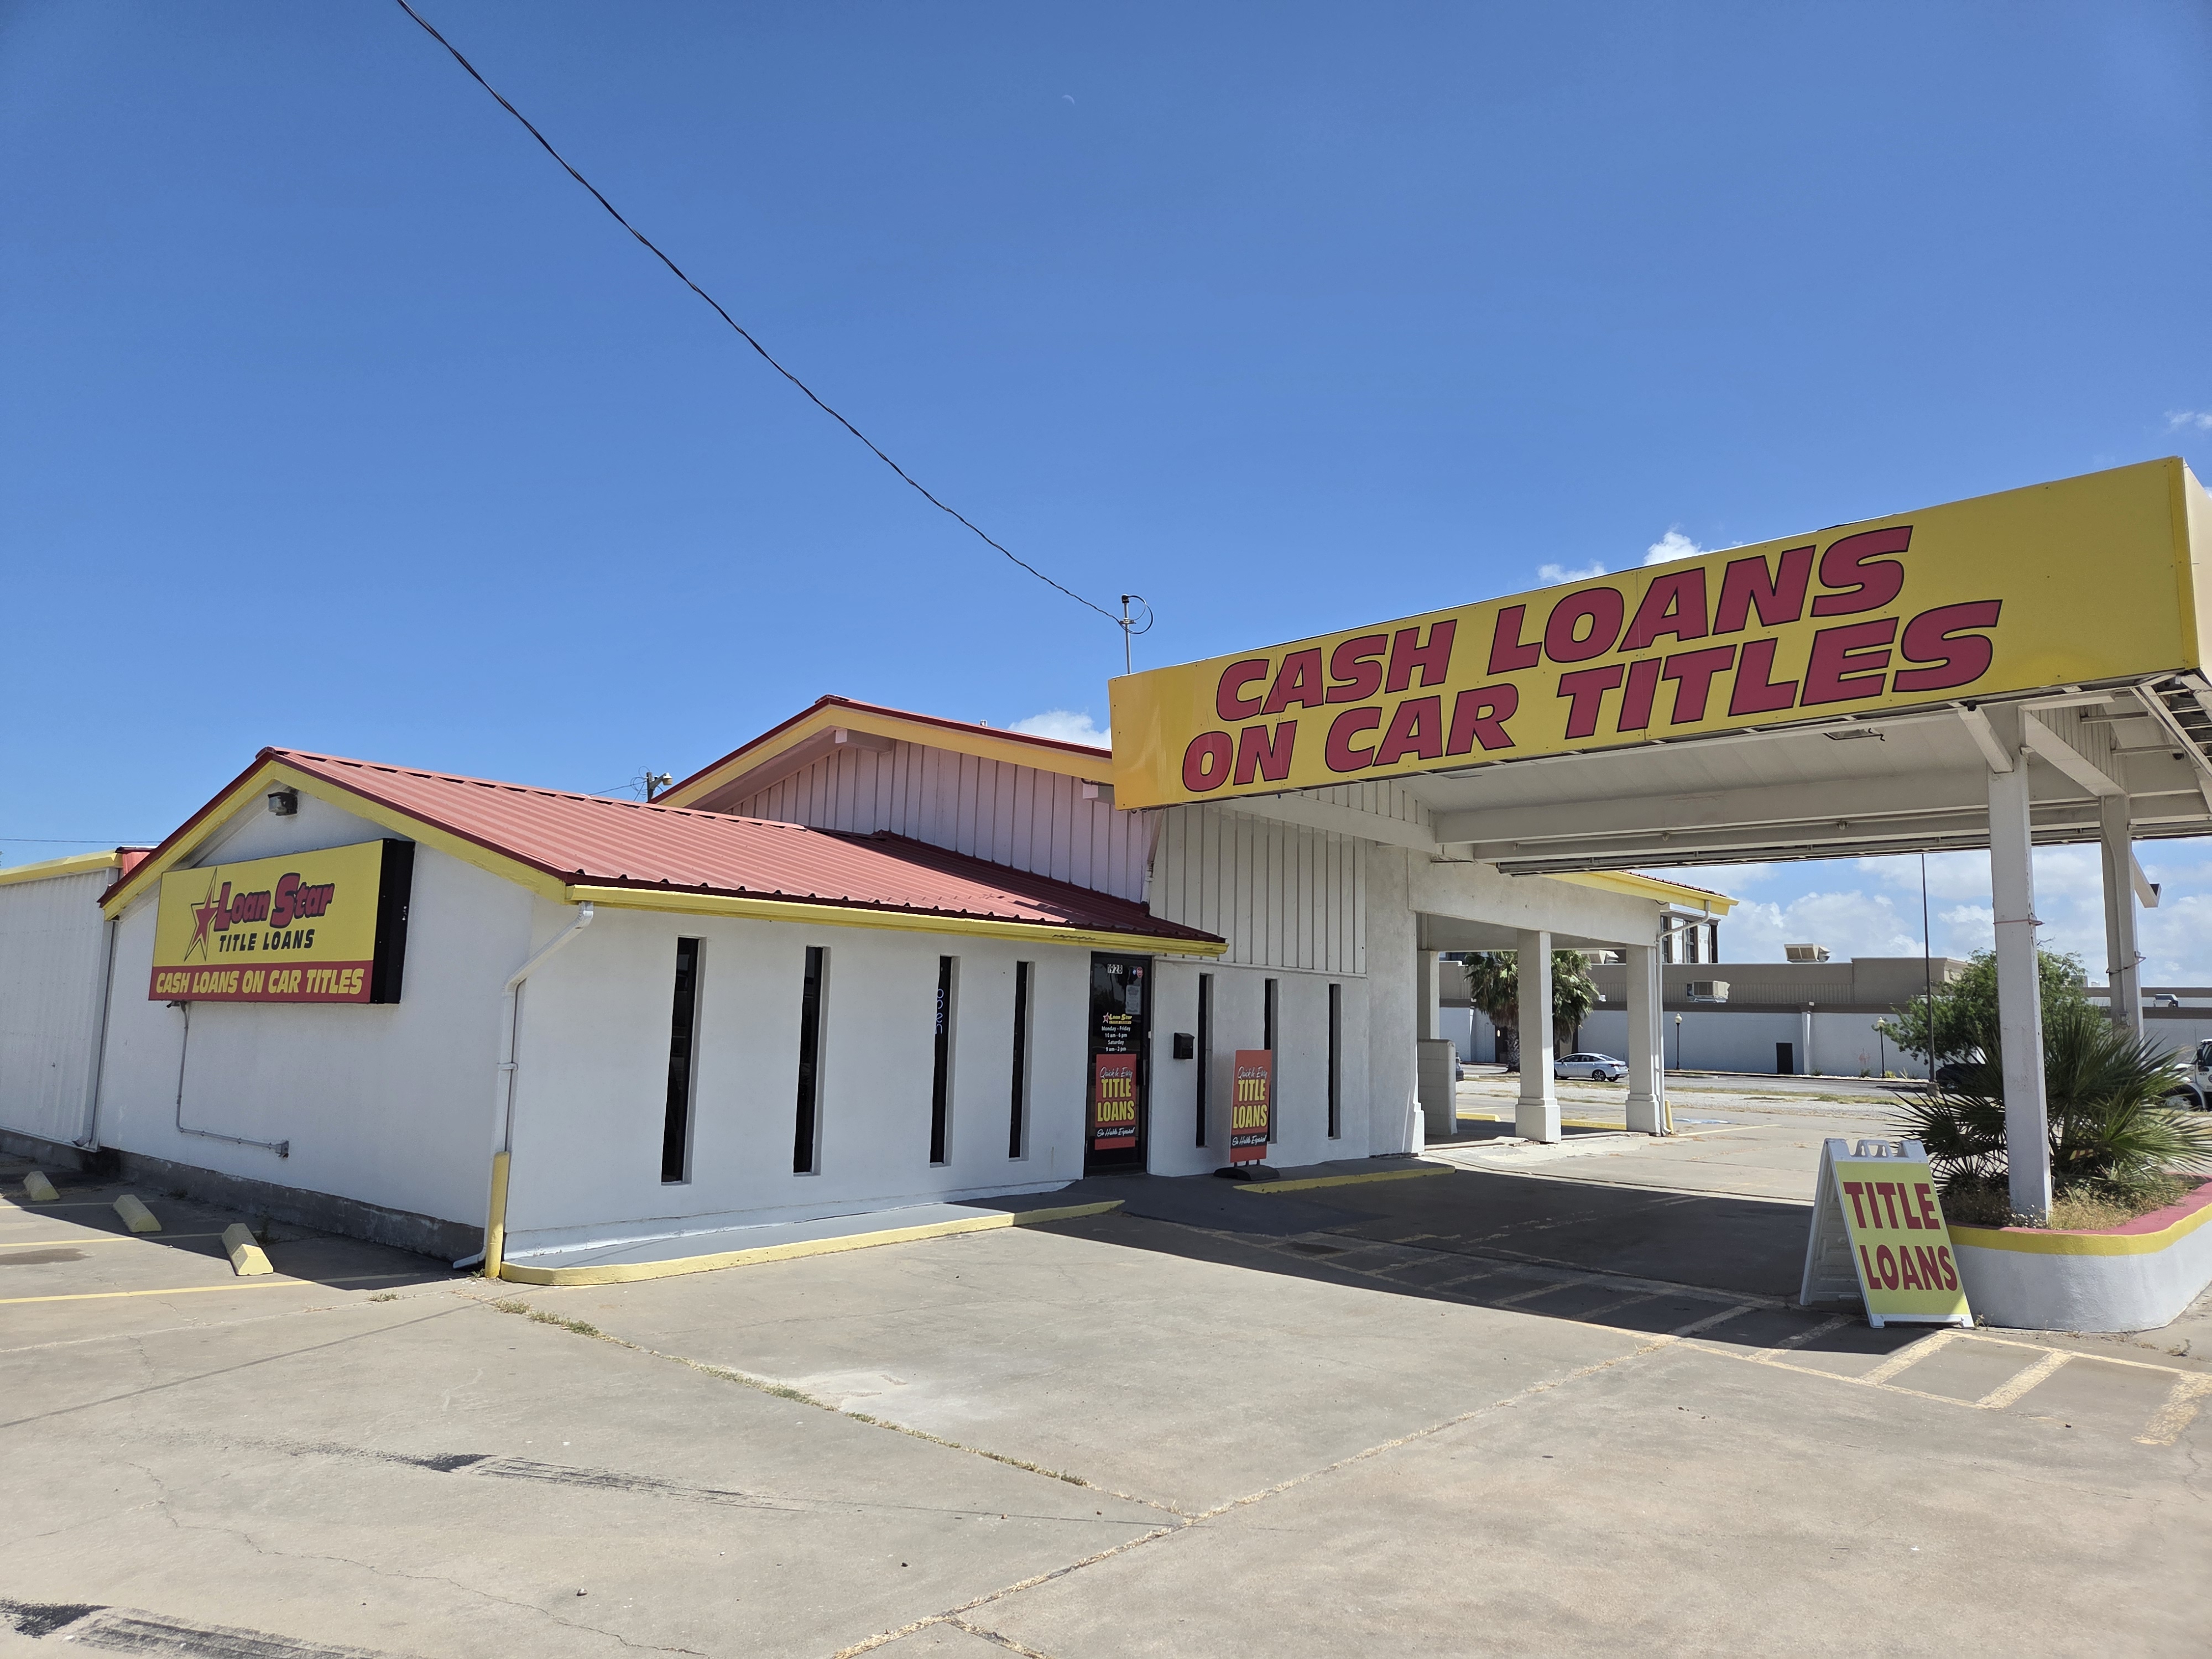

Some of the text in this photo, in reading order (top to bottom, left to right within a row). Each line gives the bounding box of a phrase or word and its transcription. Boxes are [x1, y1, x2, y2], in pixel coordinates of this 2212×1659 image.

[1216, 525, 1913, 721] CASH LOANS
[1182, 599, 2003, 792] ON CAR TITLES
[213, 872, 335, 932] Loan Star
[219, 929, 315, 952] TITLE LOANS
[155, 968, 365, 994] CASH LOANS ON CAR TITLES
[1108, 964, 1122, 973] 1928
[1101, 1078, 1131, 1098] TITLE
[1238, 1079, 1265, 1102] TITLE
[1097, 1100, 1134, 1121] LOANS
[1233, 1104, 1267, 1129] LOANS
[1843, 1181, 1941, 1230] TITLE
[1859, 1244, 1958, 1291] LOANS
